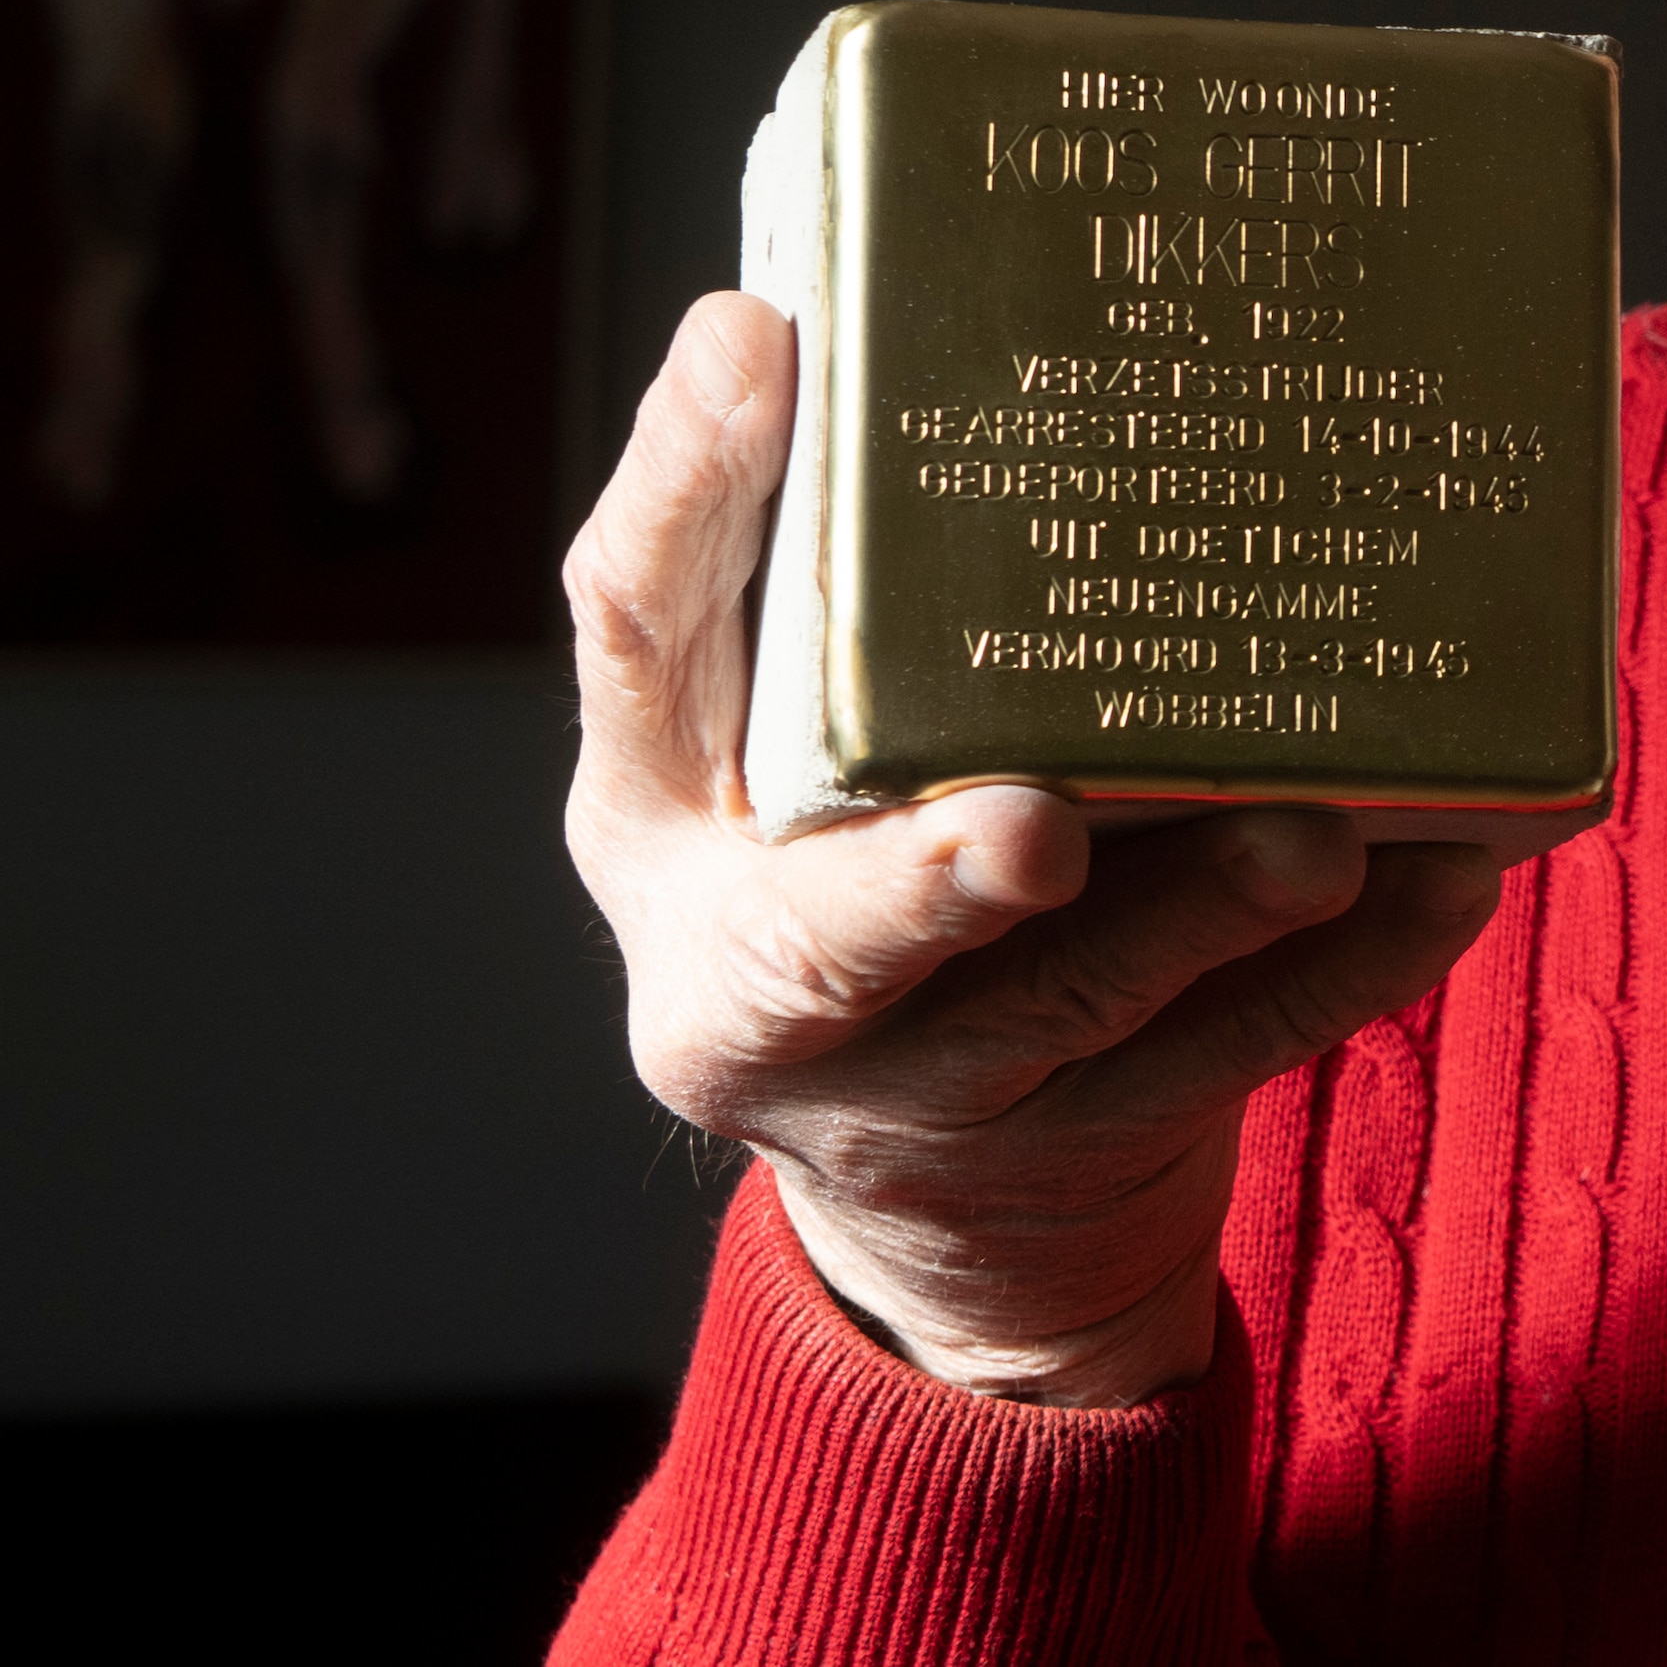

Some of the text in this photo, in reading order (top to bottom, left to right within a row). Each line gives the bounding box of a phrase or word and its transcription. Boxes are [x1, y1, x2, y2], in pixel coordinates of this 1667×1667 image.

[1062, 71, 1396, 123] HIER WOONDE
[985, 122, 1422, 207] KOOS GERRIT
[1091, 213, 1365, 290] DIKKERS
[1108, 299, 1345, 346] GEB. 1922
[1012, 354, 1443, 406] VERZETSSTRIJDER
[901, 405, 1544, 462] GEARRESTEERD 14-10-1944
[919, 460, 1528, 514] GEDEPORTEERD 3-2-1945
[1029, 518, 1418, 566] UIT DOETICHEM
[1047, 576, 1378, 622] NEUENGAMME
[963, 629, 1469, 678] VERMOORD 13-3-1945
[1095, 685, 1338, 733] WÖBBELIN
